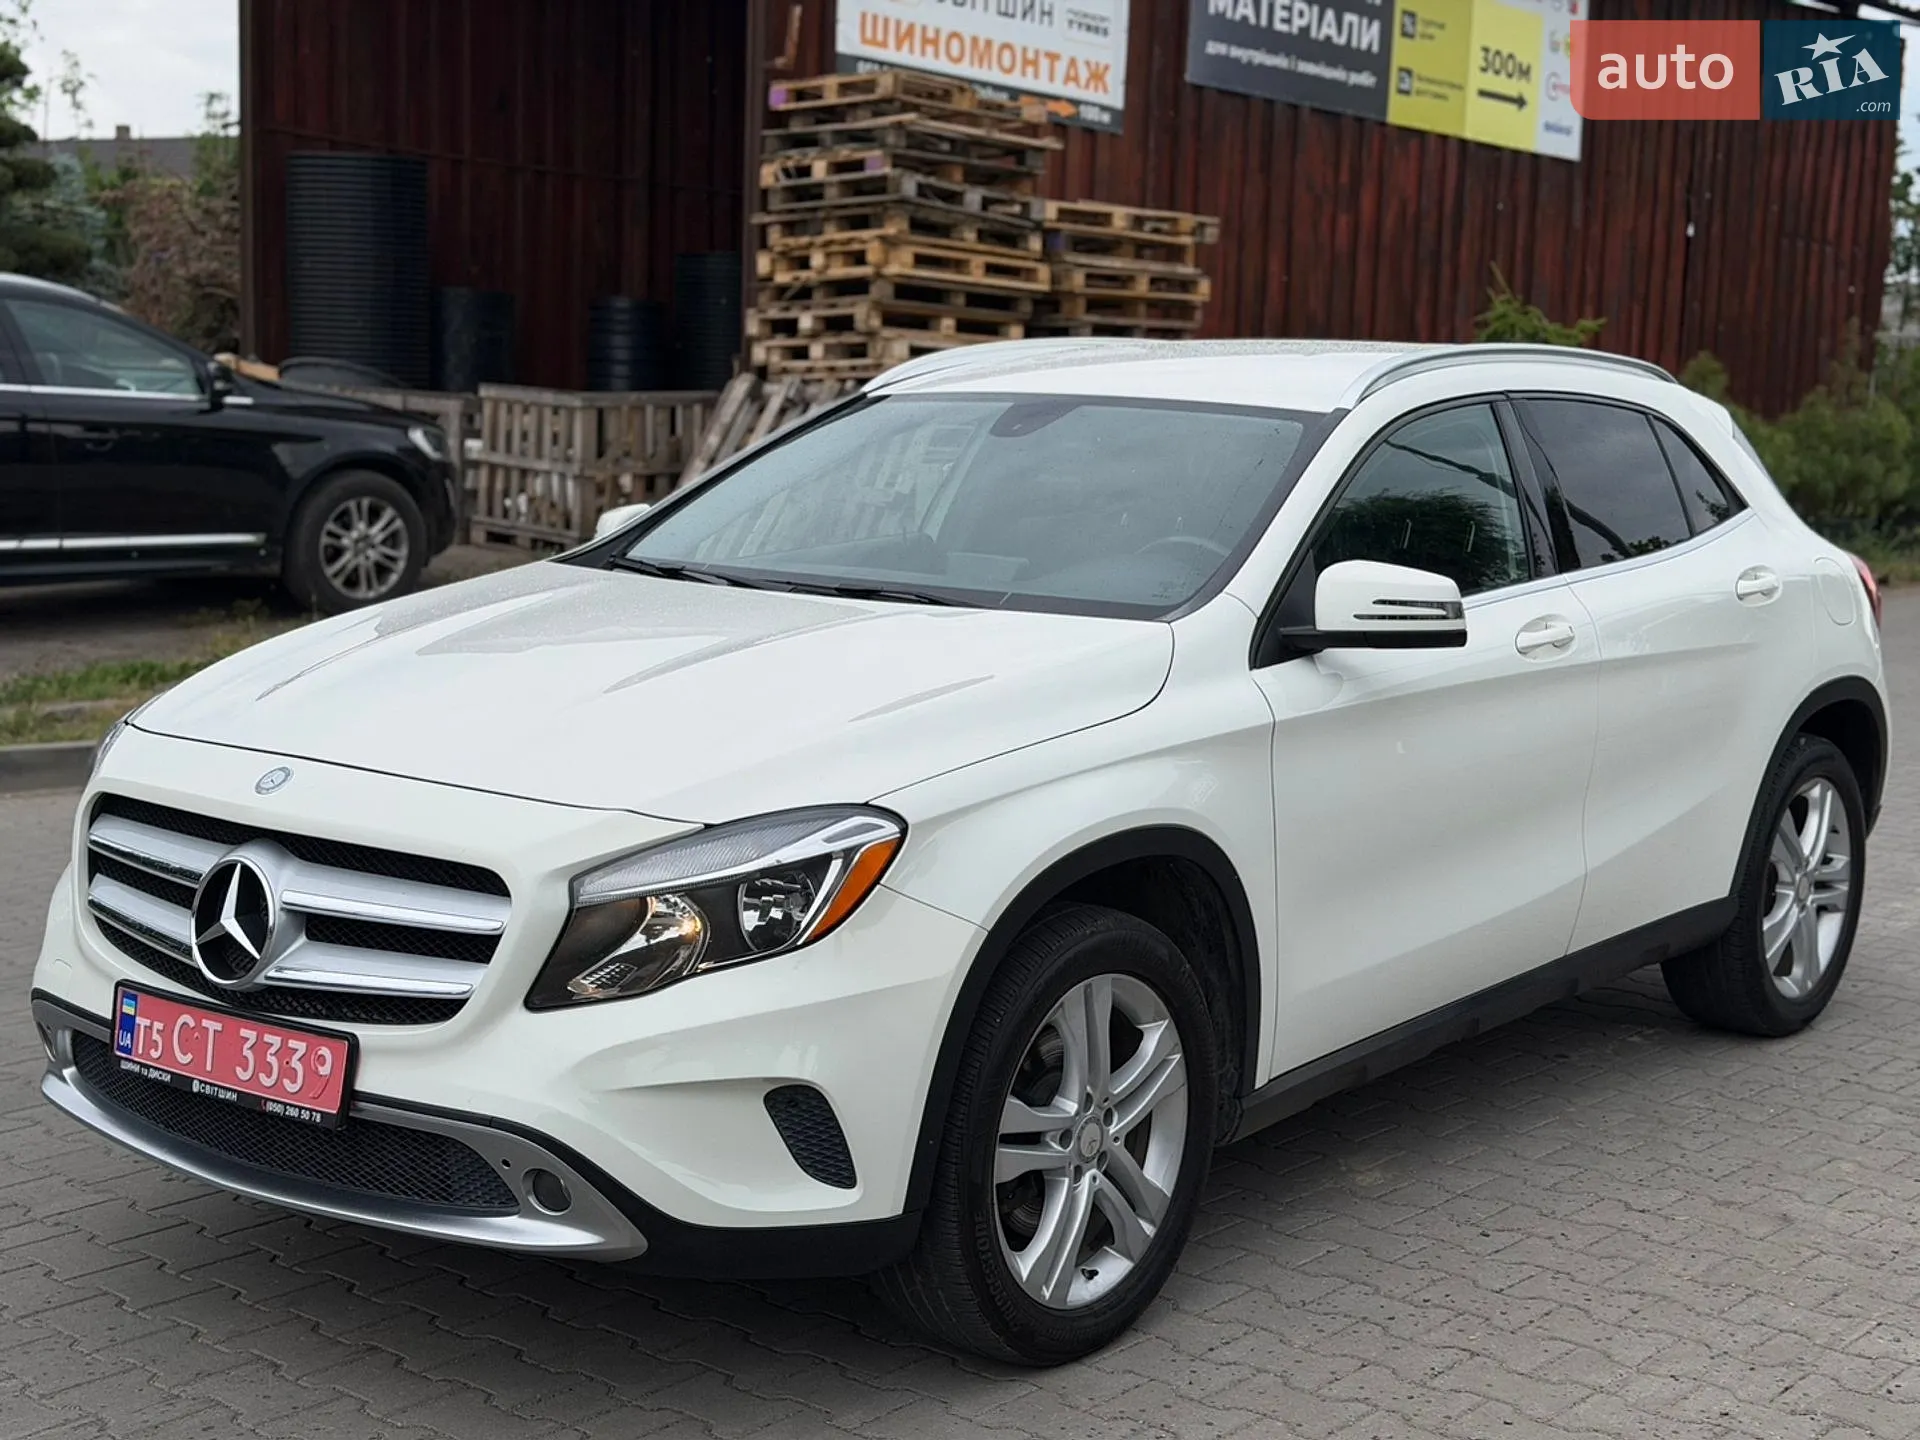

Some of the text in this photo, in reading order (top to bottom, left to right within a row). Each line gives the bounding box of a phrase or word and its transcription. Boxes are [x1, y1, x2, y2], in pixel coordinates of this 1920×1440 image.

[859, 11, 1111, 94] ШИНОМОНТАЖ
[119, 1029, 132, 1048] UA
[200, 1083, 238, 1102] СВІТШИН
